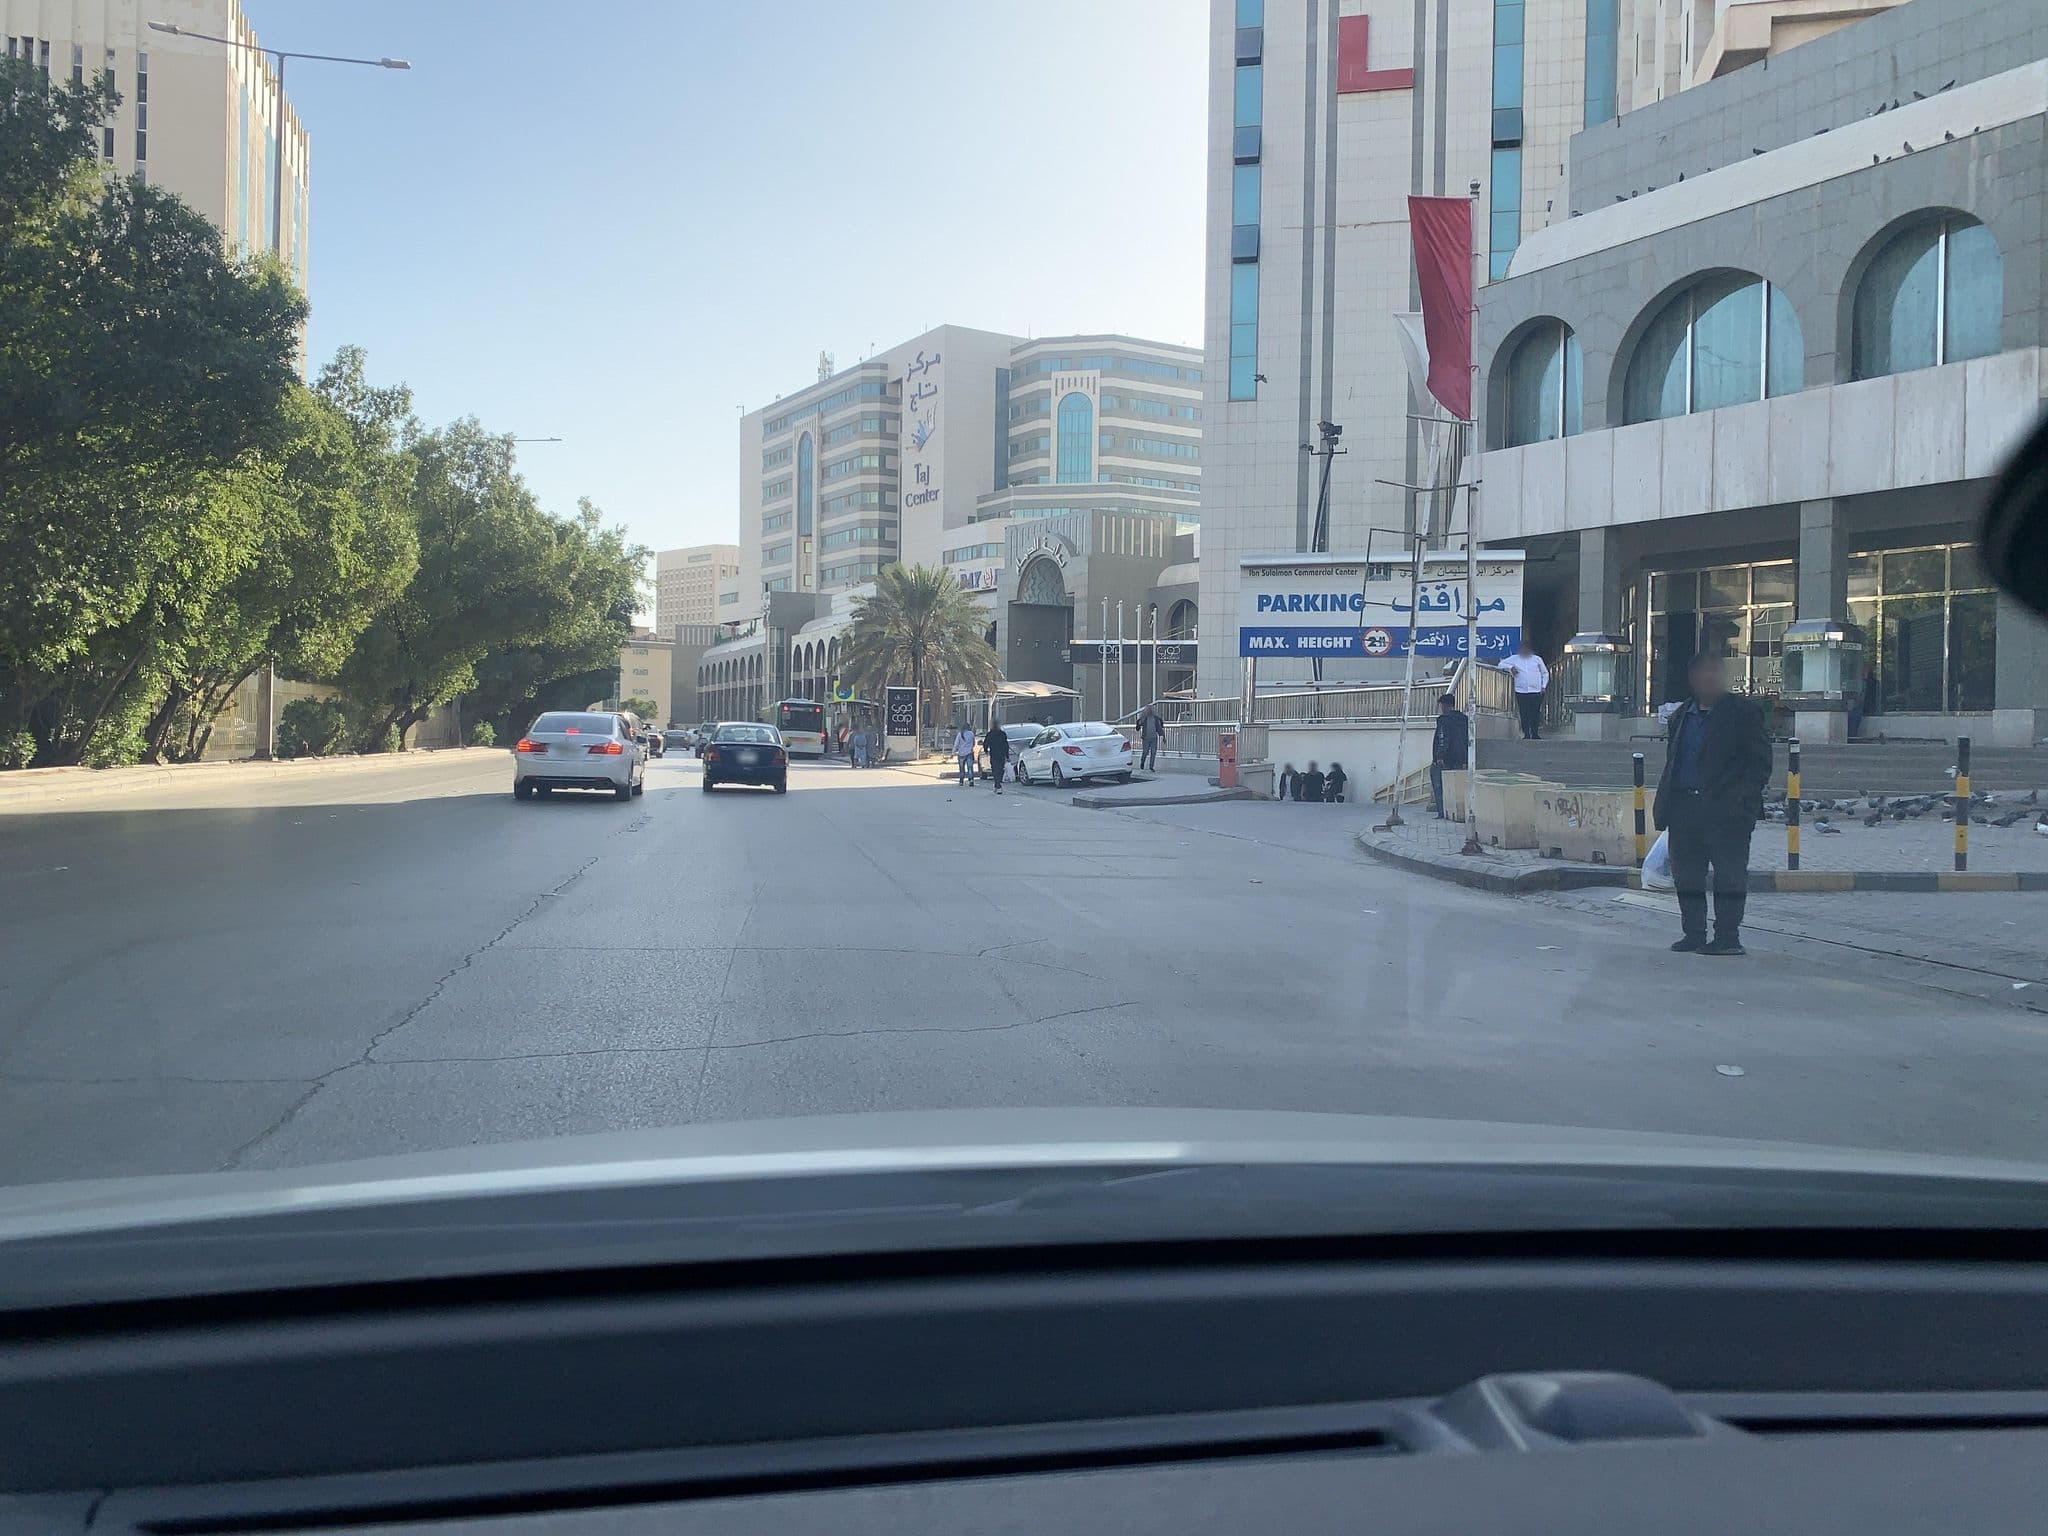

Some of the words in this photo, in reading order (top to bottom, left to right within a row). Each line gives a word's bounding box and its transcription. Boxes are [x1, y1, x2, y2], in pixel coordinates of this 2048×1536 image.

[907, 350, 941, 382] مركز
[910, 382, 938, 412] تاج
[914, 462, 930, 485] Taj
[905, 489, 940, 507] Center
[1248, 569, 1260, 577] Ibn
[1294, 568, 1334, 577] Commercial
[1335, 568, 1358, 576] Center
[1489, 566, 1514, 576] مركز
[1257, 593, 1366, 613] PARKING
[1249, 636, 1290, 649] MAX.
[1297, 636, 1354, 649] HEIGHT
[1456, 634, 1510, 651] الإرتفع
